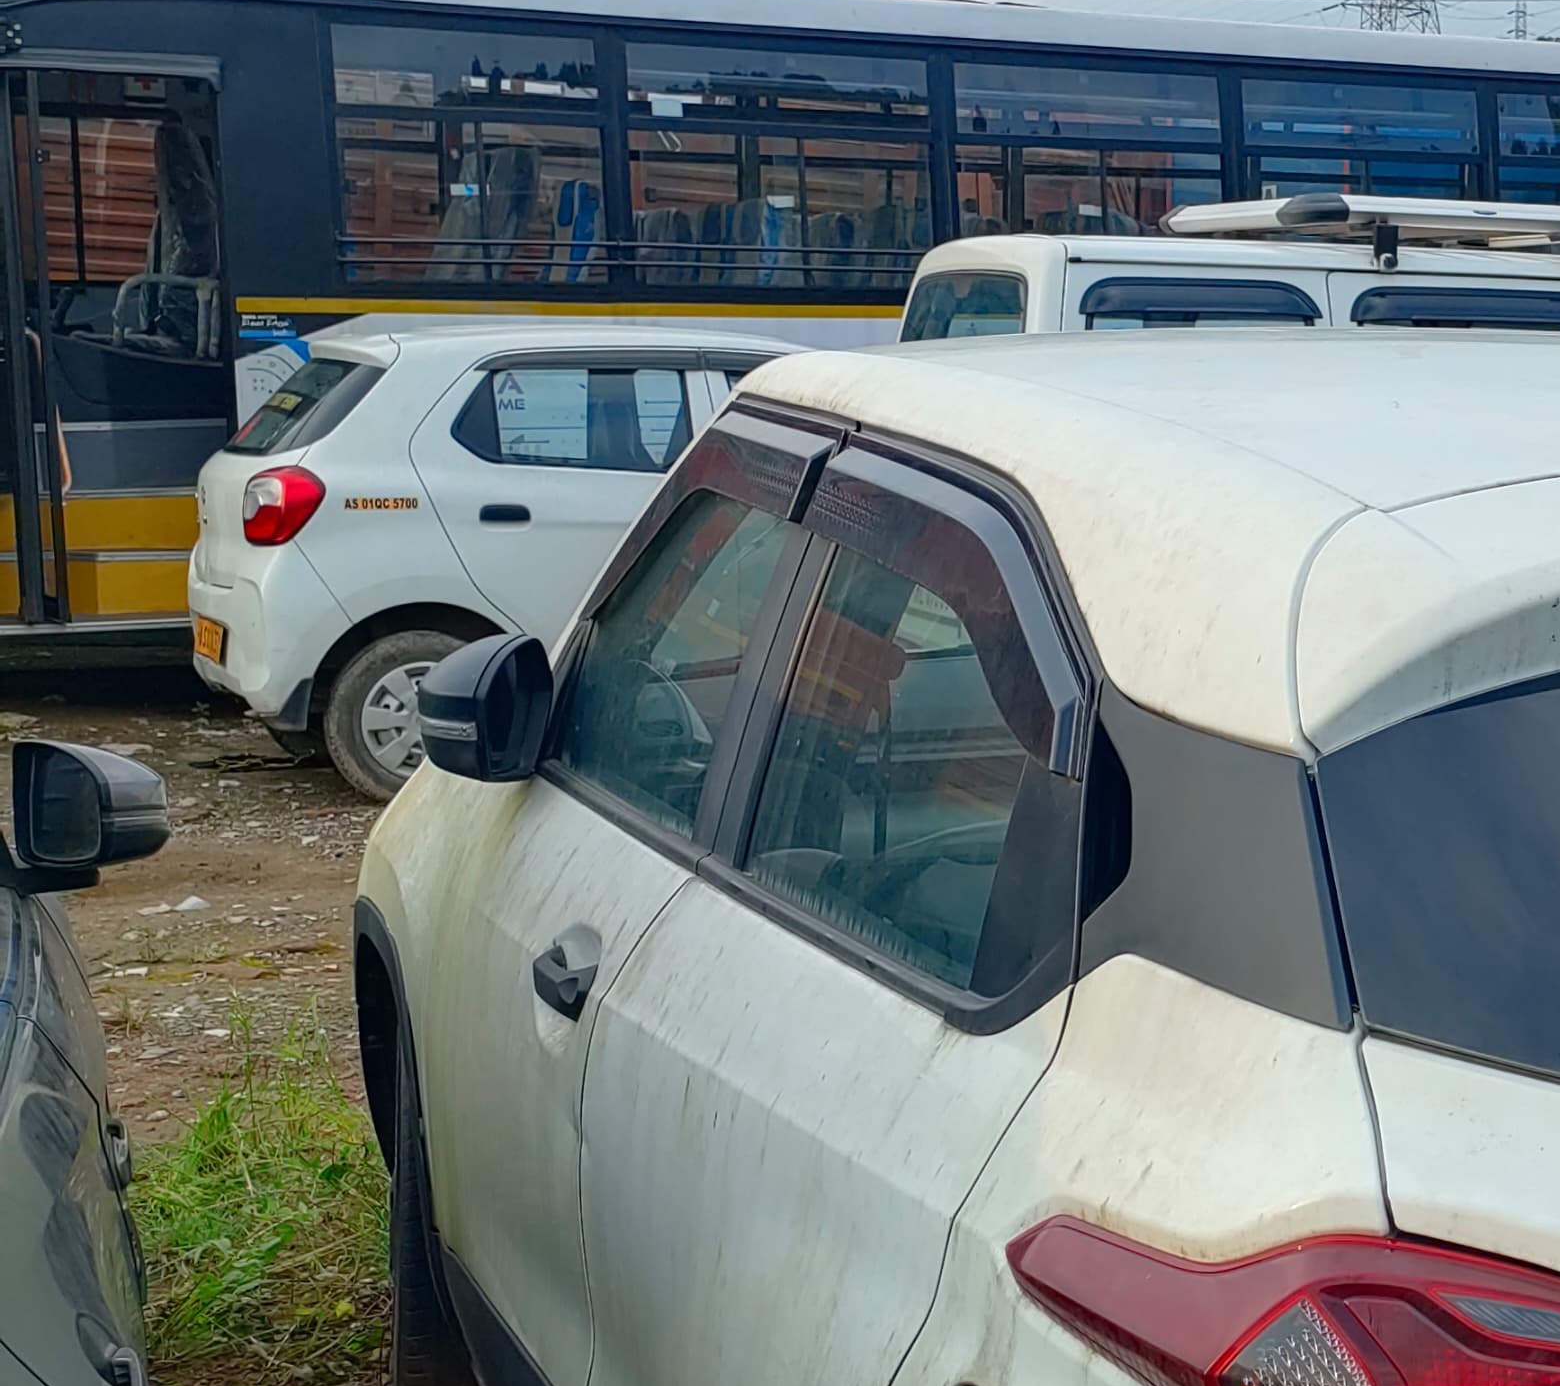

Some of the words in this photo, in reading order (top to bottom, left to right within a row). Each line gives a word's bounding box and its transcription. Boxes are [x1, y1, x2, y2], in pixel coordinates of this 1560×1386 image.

[344, 498, 359, 509] AS
[361, 498, 390, 509] 01QC
[393, 497, 418, 509] 5700
